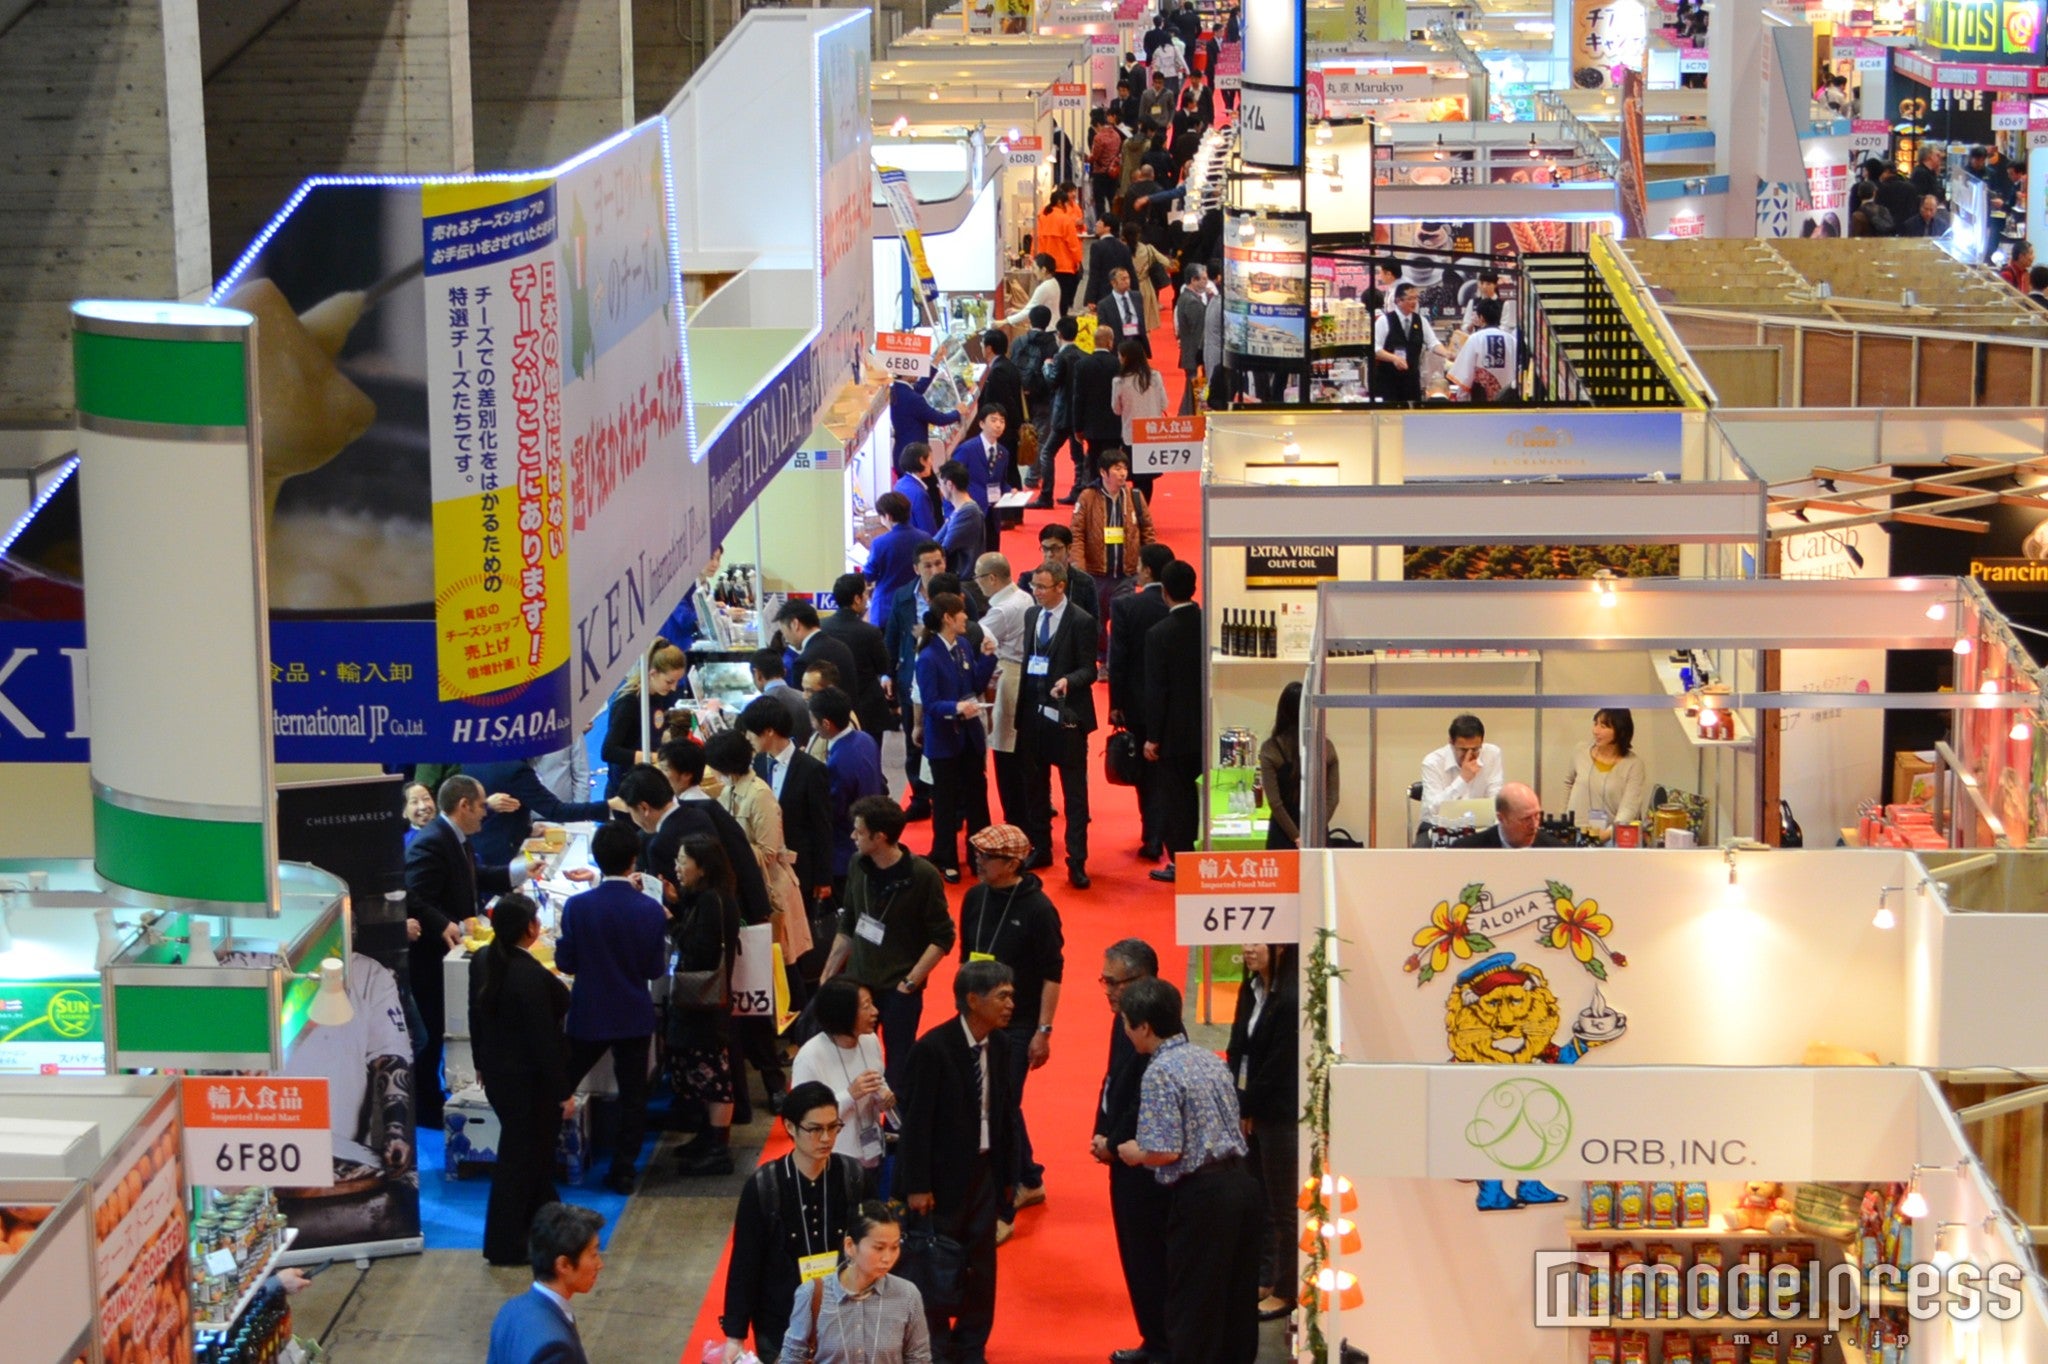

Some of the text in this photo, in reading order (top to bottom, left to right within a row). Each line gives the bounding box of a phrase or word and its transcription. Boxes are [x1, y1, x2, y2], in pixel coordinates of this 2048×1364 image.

[1354, 82, 1404, 95] Marukyo
[1009, 154, 1036, 164] 6D80
[432, 200, 545, 241] 売れるチーズショップの
[886, 357, 919, 371] 6E80
[448, 287, 474, 484] 特選チーズたちです。
[540, 260, 564, 560] 日本の他社にはない
[474, 286, 502, 594] チーズでの差別化をはかるための
[741, 370, 800, 495] HISADA
[1148, 449, 1191, 466] 6E79
[1250, 546, 1335, 557] EXTRA VIRGIN
[1267, 559, 1317, 568] OLIVE OIL
[446, 615, 521, 643] チーズショップ
[577, 550, 645, 702] KEN
[464, 637, 511, 661] 売上げ
[369, 706, 390, 744] JP
[452, 707, 557, 743] HISADA
[1198, 857, 1279, 879] 輸入食品
[1257, 880, 1277, 888] Mart
[1203, 906, 1276, 932] 6F77
[1480, 900, 1539, 931] ALOHA
[56, 998, 90, 1013] SUN
[208, 1085, 303, 1110] 輸入食品
[255, 1112, 277, 1121] Food
[278, 1113, 300, 1121] Mart
[216, 1143, 301, 1172] 6F80
[1580, 1138, 1757, 1170] ORB,INC.
